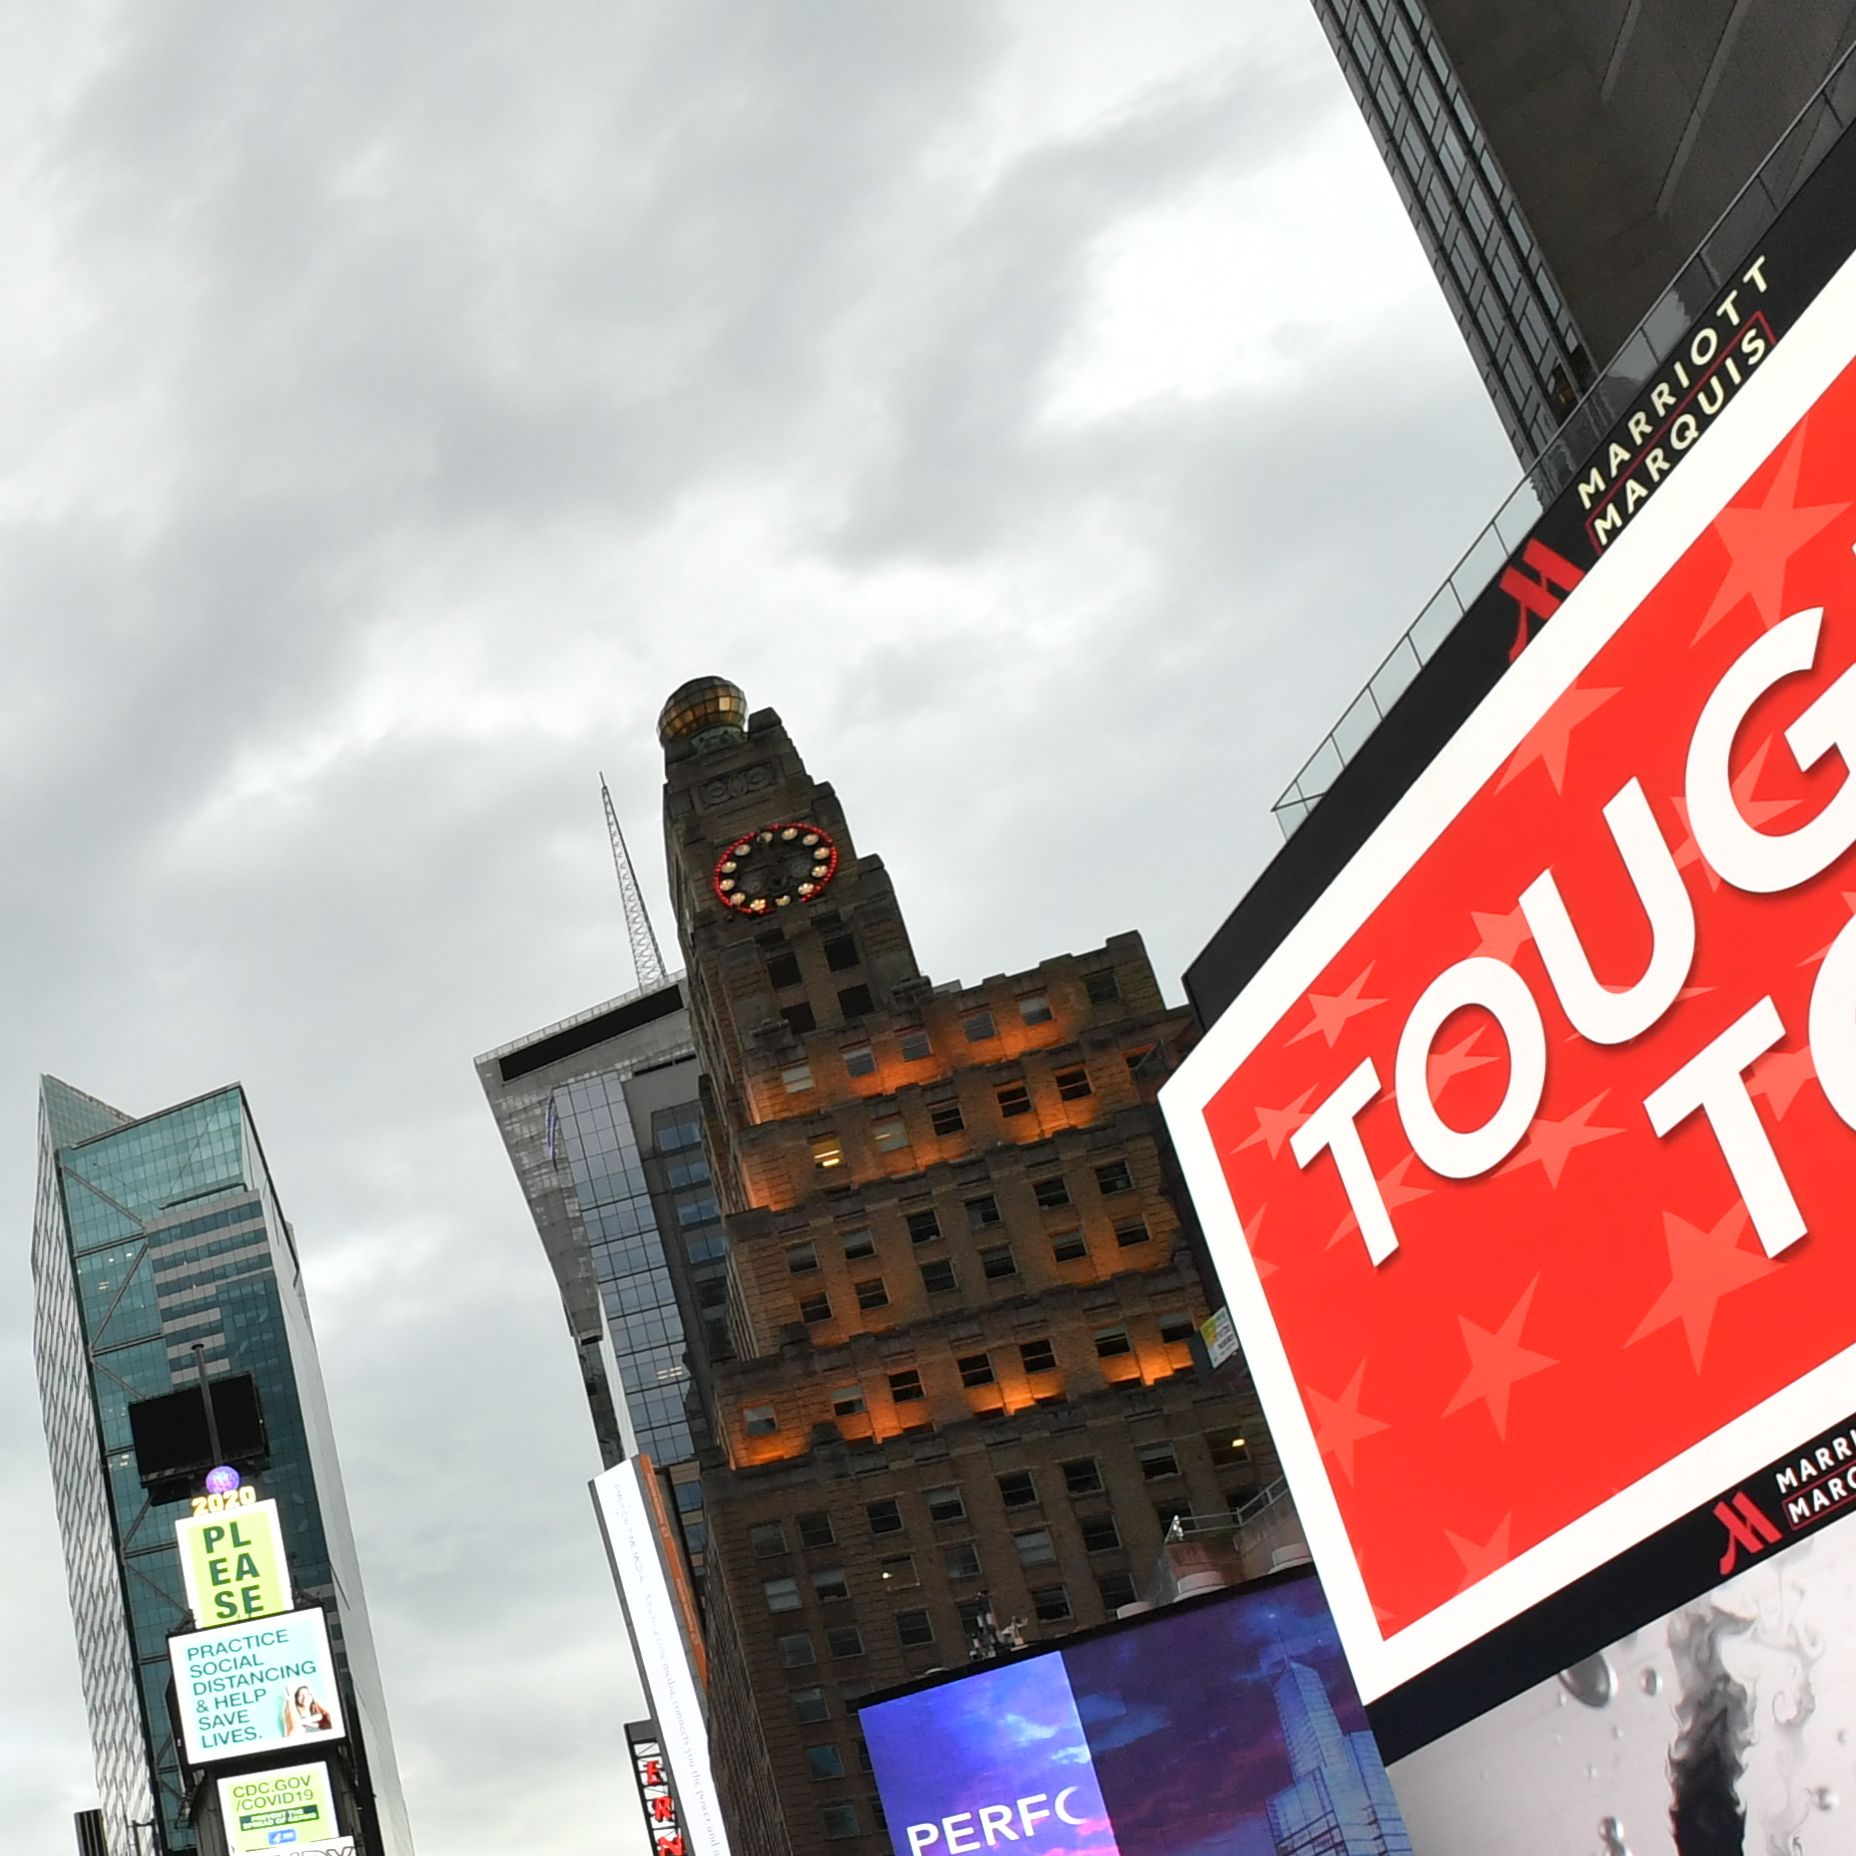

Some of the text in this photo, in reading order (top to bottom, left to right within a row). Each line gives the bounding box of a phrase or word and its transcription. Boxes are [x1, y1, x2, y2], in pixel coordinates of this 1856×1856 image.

[1577, 254, 1772, 512] MARRIOTT
[1591, 327, 1766, 547] MARQUIS
[1289, 604, 1856, 1268] TOUG
[191, 1486, 256, 1516] 2020
[203, 1522, 252, 1555] PL
[208, 1552, 261, 1587] EA
[214, 1584, 265, 1620] SE
[187, 1629, 290, 1662] PRACTICE
[189, 1653, 265, 1679] SOCIAL
[193, 1660, 317, 1697] DISTANCING
[196, 1687, 267, 1714] & HELP
[198, 1709, 251, 1732] SAVE
[672, 1700, 689, 1748] connects
[201, 1726, 263, 1750] LIVES.
[684, 1748, 696, 1770] you
[232, 1775, 312, 1798] CDC.GOV
[690, 1767, 700, 1787] the
[235, 1789, 315, 1813] /COVID19
[697, 1789, 712, 1828] power
[702, 1827, 721, 1849] and
